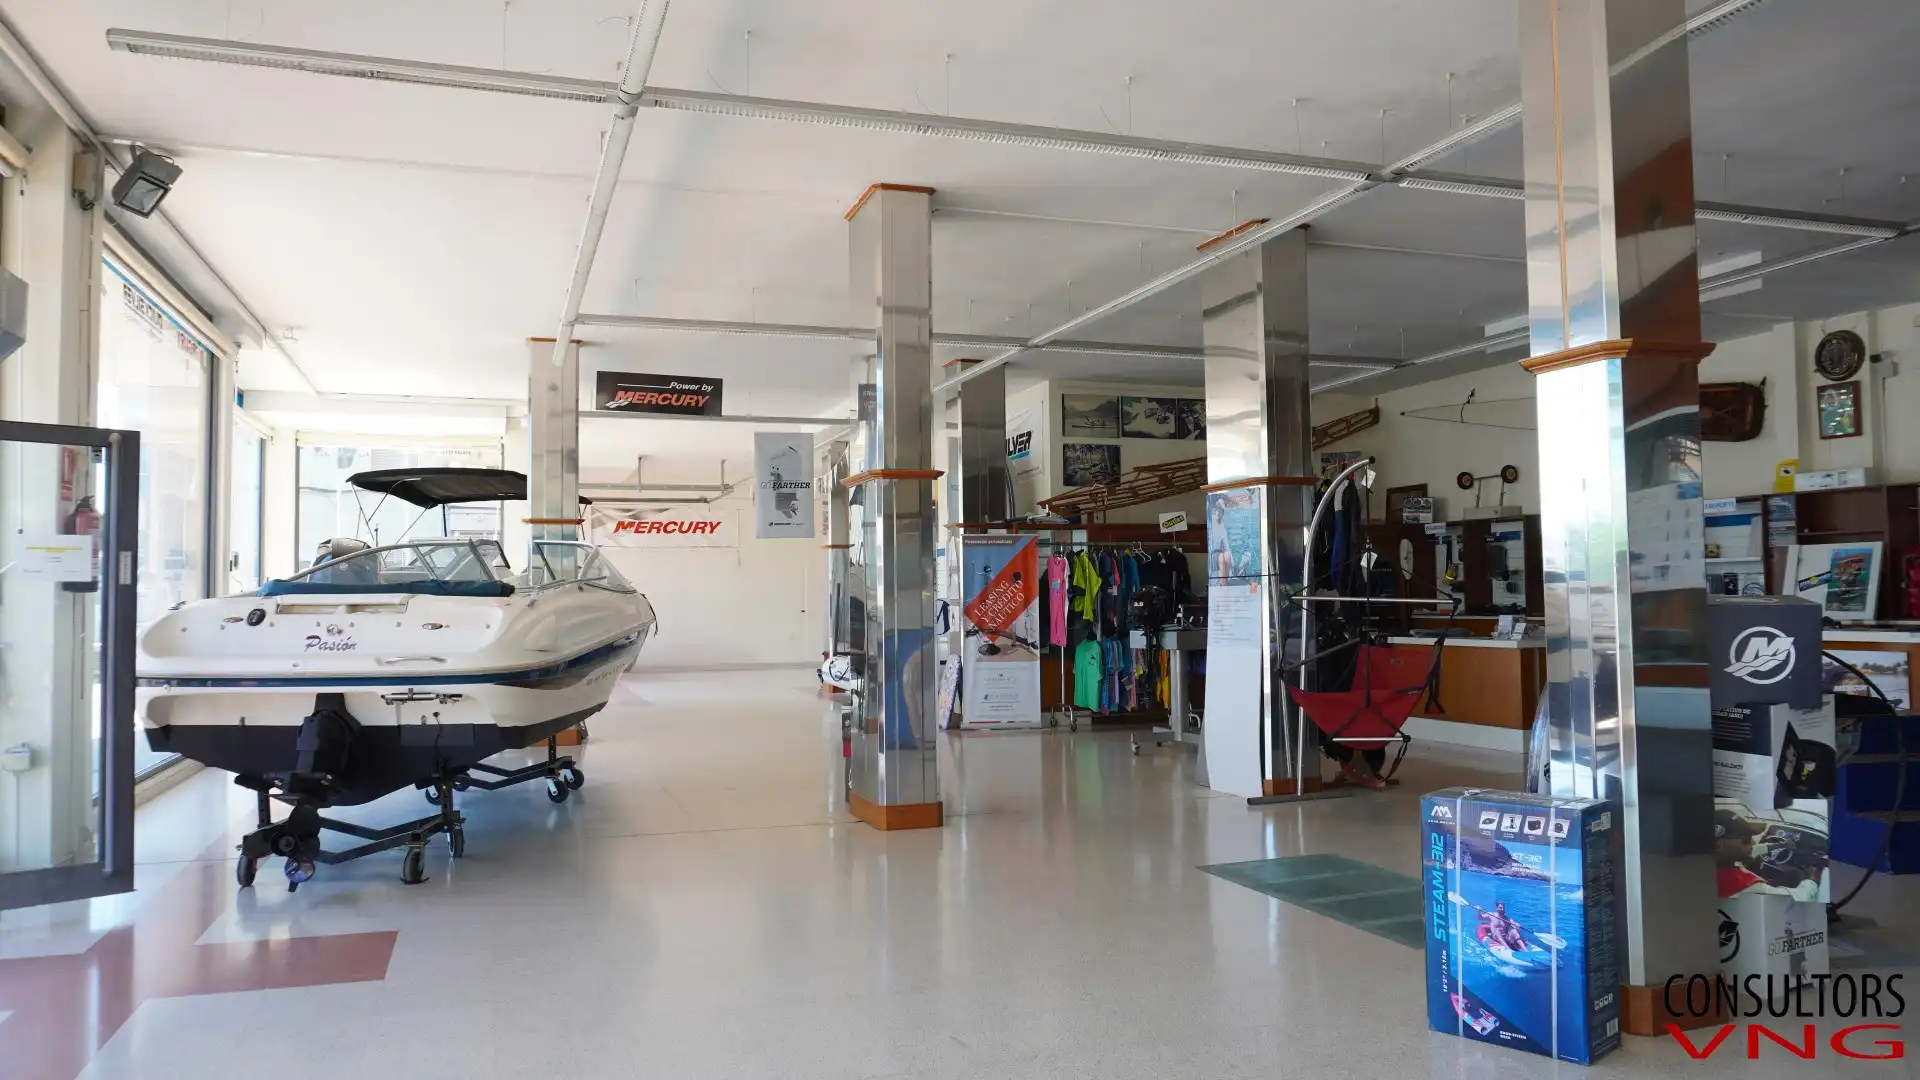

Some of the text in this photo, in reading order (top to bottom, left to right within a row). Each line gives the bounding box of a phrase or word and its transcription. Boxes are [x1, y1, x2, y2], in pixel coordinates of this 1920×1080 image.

[669, 381, 714, 393] Power by
[606, 390, 710, 408] MERCURY
[772, 481, 811, 490] FARTHER
[613, 520, 722, 534] MERCURY
[974, 580, 1009, 616] LEASING
[304, 635, 358, 653] Pasión
[1511, 851, 1543, 864] ST-312
[1433, 832, 1447, 943] STEAM-312
[1781, 931, 1825, 953] FARTHER
